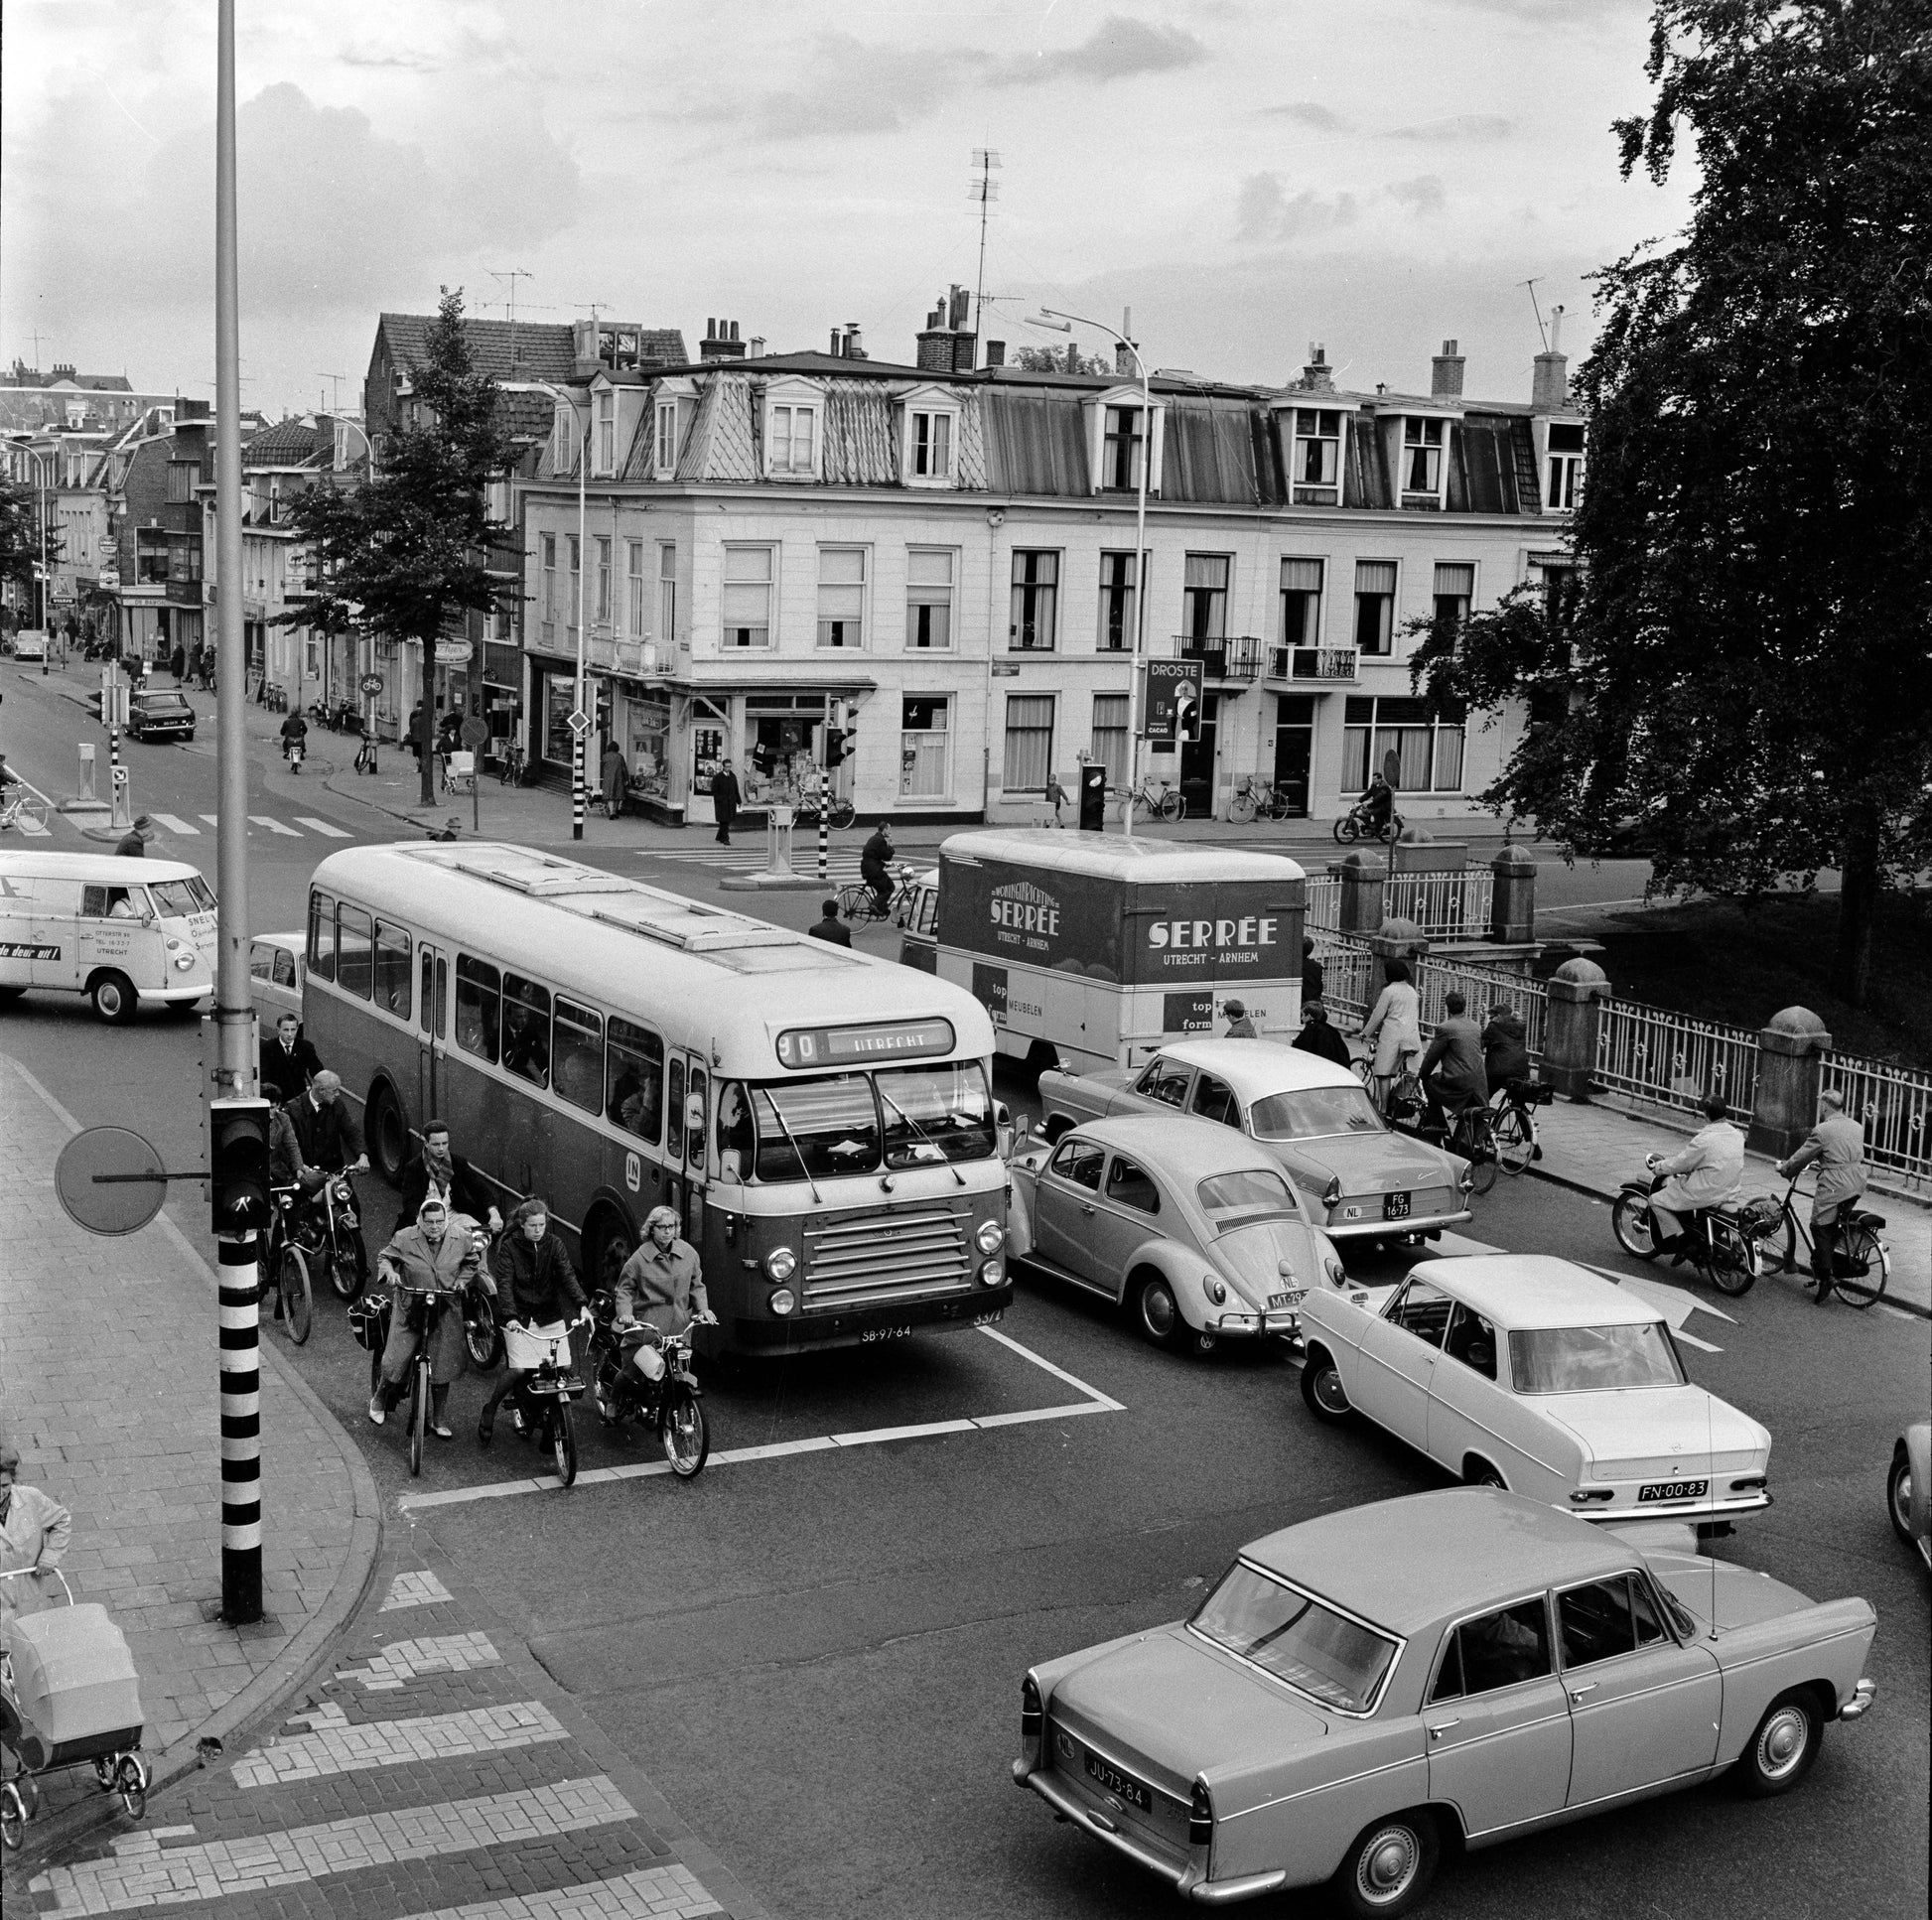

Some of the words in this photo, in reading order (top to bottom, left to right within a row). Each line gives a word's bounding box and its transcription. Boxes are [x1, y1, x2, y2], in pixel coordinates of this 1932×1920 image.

[1152, 664, 1197, 677] DROSTE
[189, 917, 209, 926] SNEL
[998, 930, 1021, 945] UTRECHT
[1026, 937, 1048, 951] ARNHEM
[12, 945, 36, 958] deur
[1164, 954, 1206, 965] UTRECHT
[1219, 952, 1259, 963] ARNHEM
[993, 983, 1007, 999] top
[1008, 1000, 1042, 1017] MEUBELEN
[1192, 1002, 1211, 1015] top
[1217, 1009, 1267, 1019] MELEN
[1182, 1019, 1211, 1029] form
[854, 1034, 924, 1052] UTRECHT
[1392, 1193, 1404, 1204] FG
[1346, 1207, 1359, 1217] NL
[1387, 1204, 1408, 1215] 16-73
[1282, 1278, 1297, 1289] NL
[862, 1325, 910, 1342] SB-97-64
[1641, 1482, 1706, 1500] FN-00-83
[1090, 1761, 1143, 1806] JU-73-84
